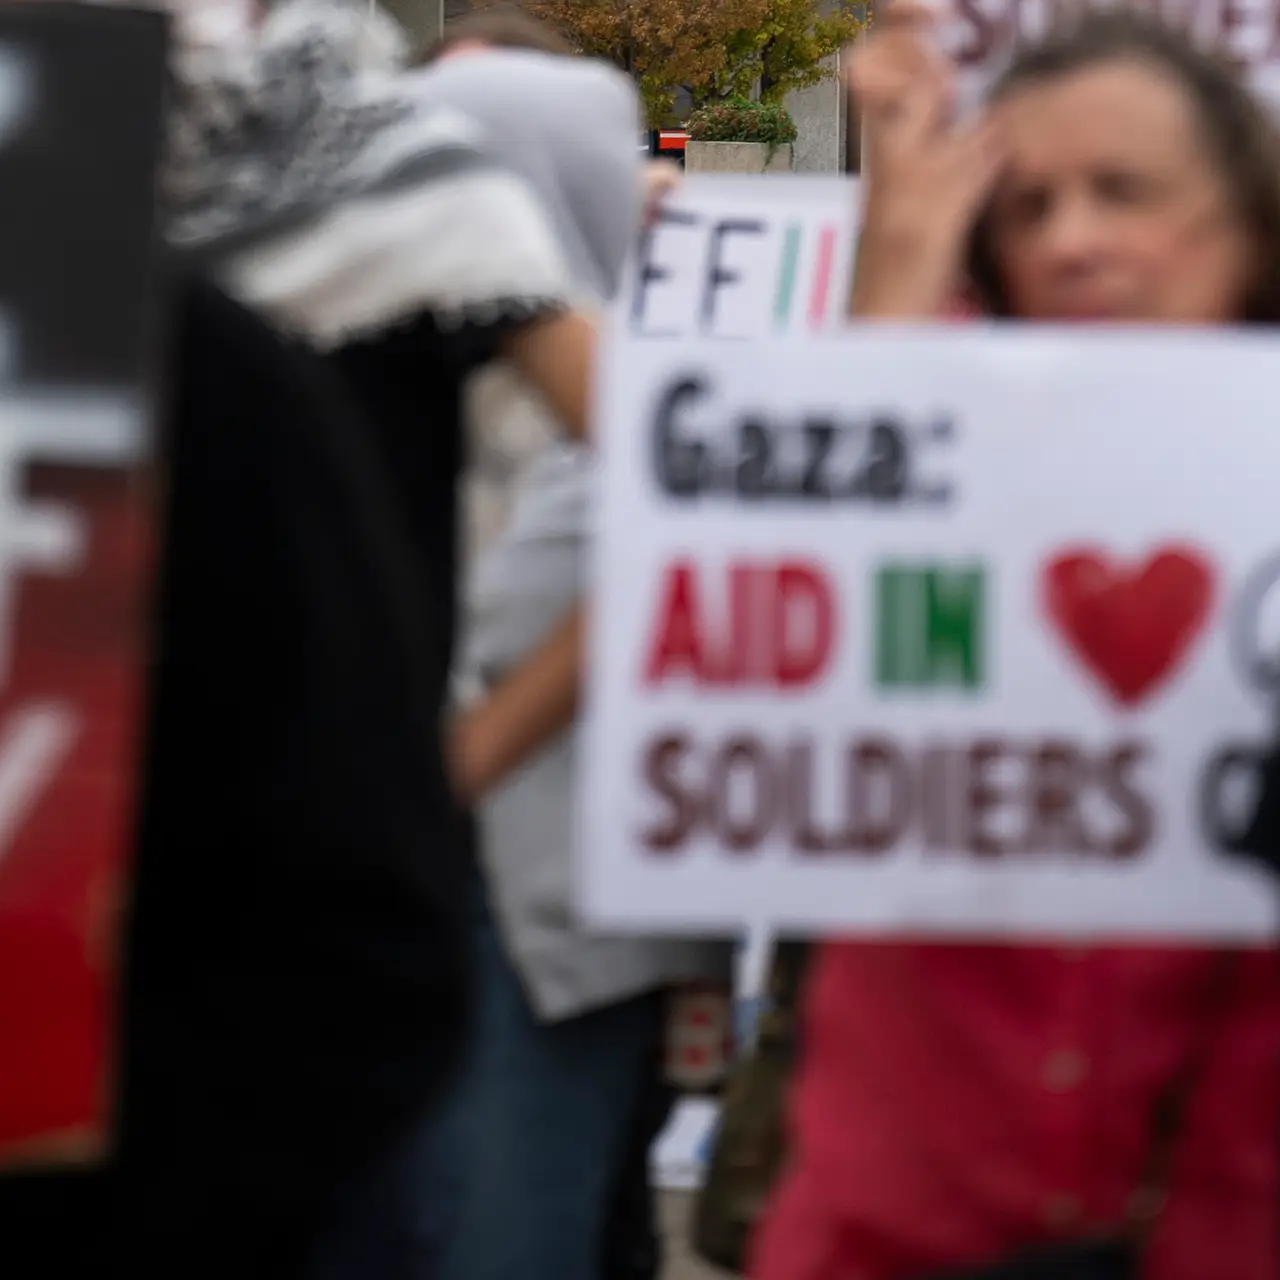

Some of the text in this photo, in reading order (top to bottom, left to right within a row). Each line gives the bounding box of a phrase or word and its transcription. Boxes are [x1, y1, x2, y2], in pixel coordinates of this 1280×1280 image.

[652, 375, 957, 504] Gaza:
[643, 558, 989, 688] AID IN
[638, 733, 1158, 860] SOLDIERS
